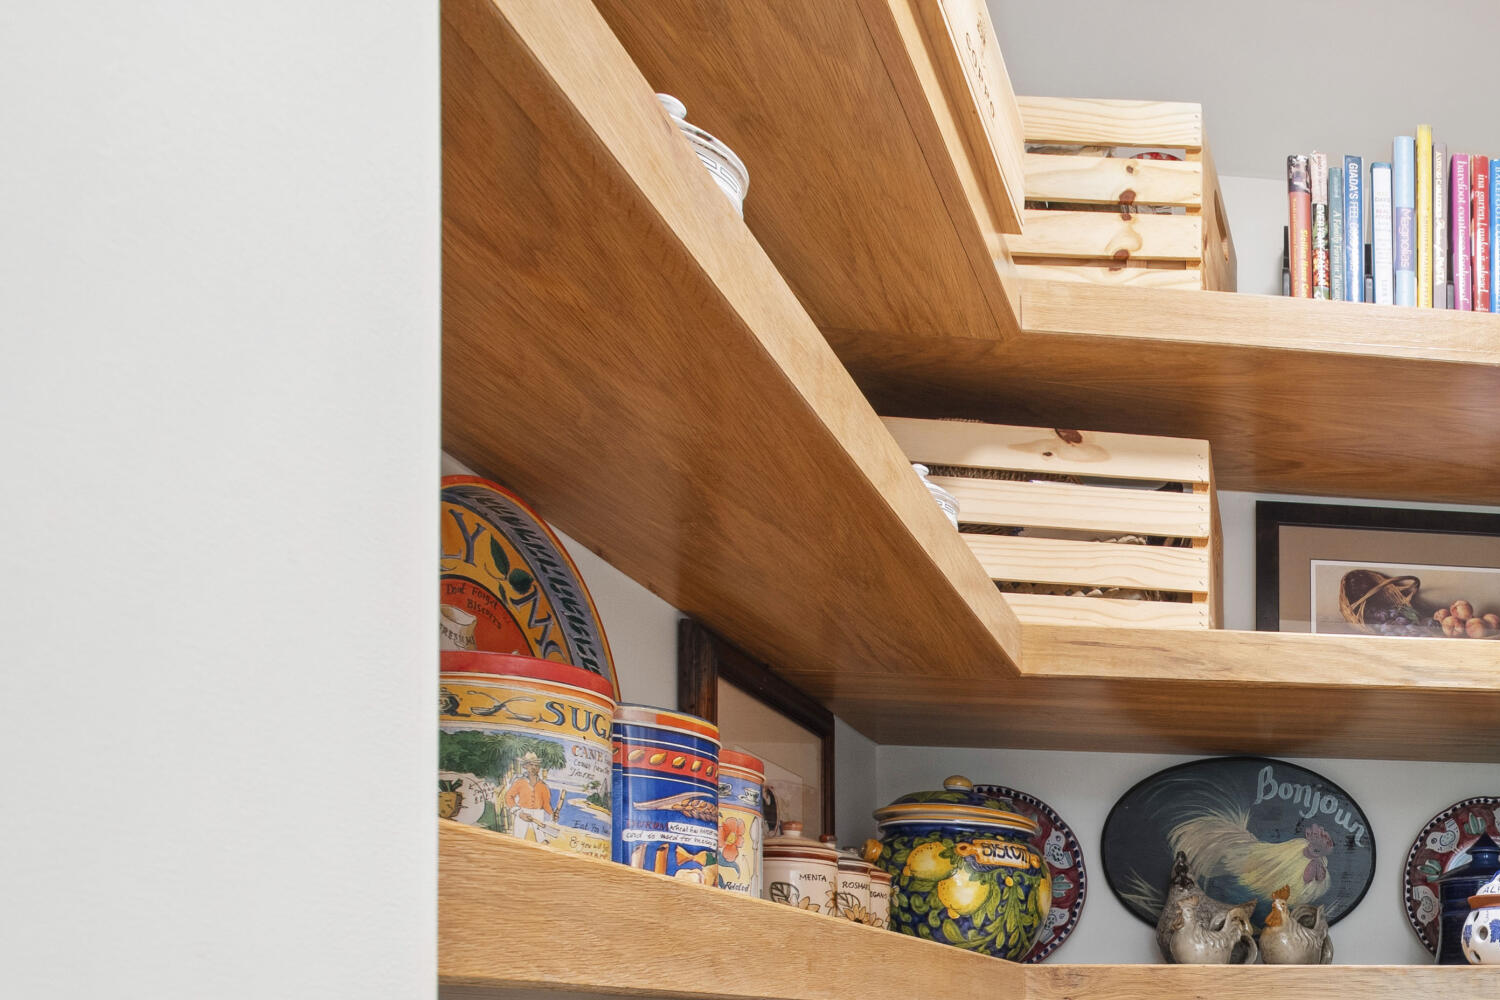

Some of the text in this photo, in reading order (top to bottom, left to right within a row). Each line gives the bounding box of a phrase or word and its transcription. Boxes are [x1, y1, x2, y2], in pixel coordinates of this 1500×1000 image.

[1349, 163, 1358, 219] GIADA'S FEEL
[1457, 161, 1466, 203] barefoot
[1476, 192, 1486, 220] garten
[1399, 208, 1411, 267] Magnolias
[1254, 765, 1367, 847] Bonjour
[799, 874, 827, 883] MENTA
